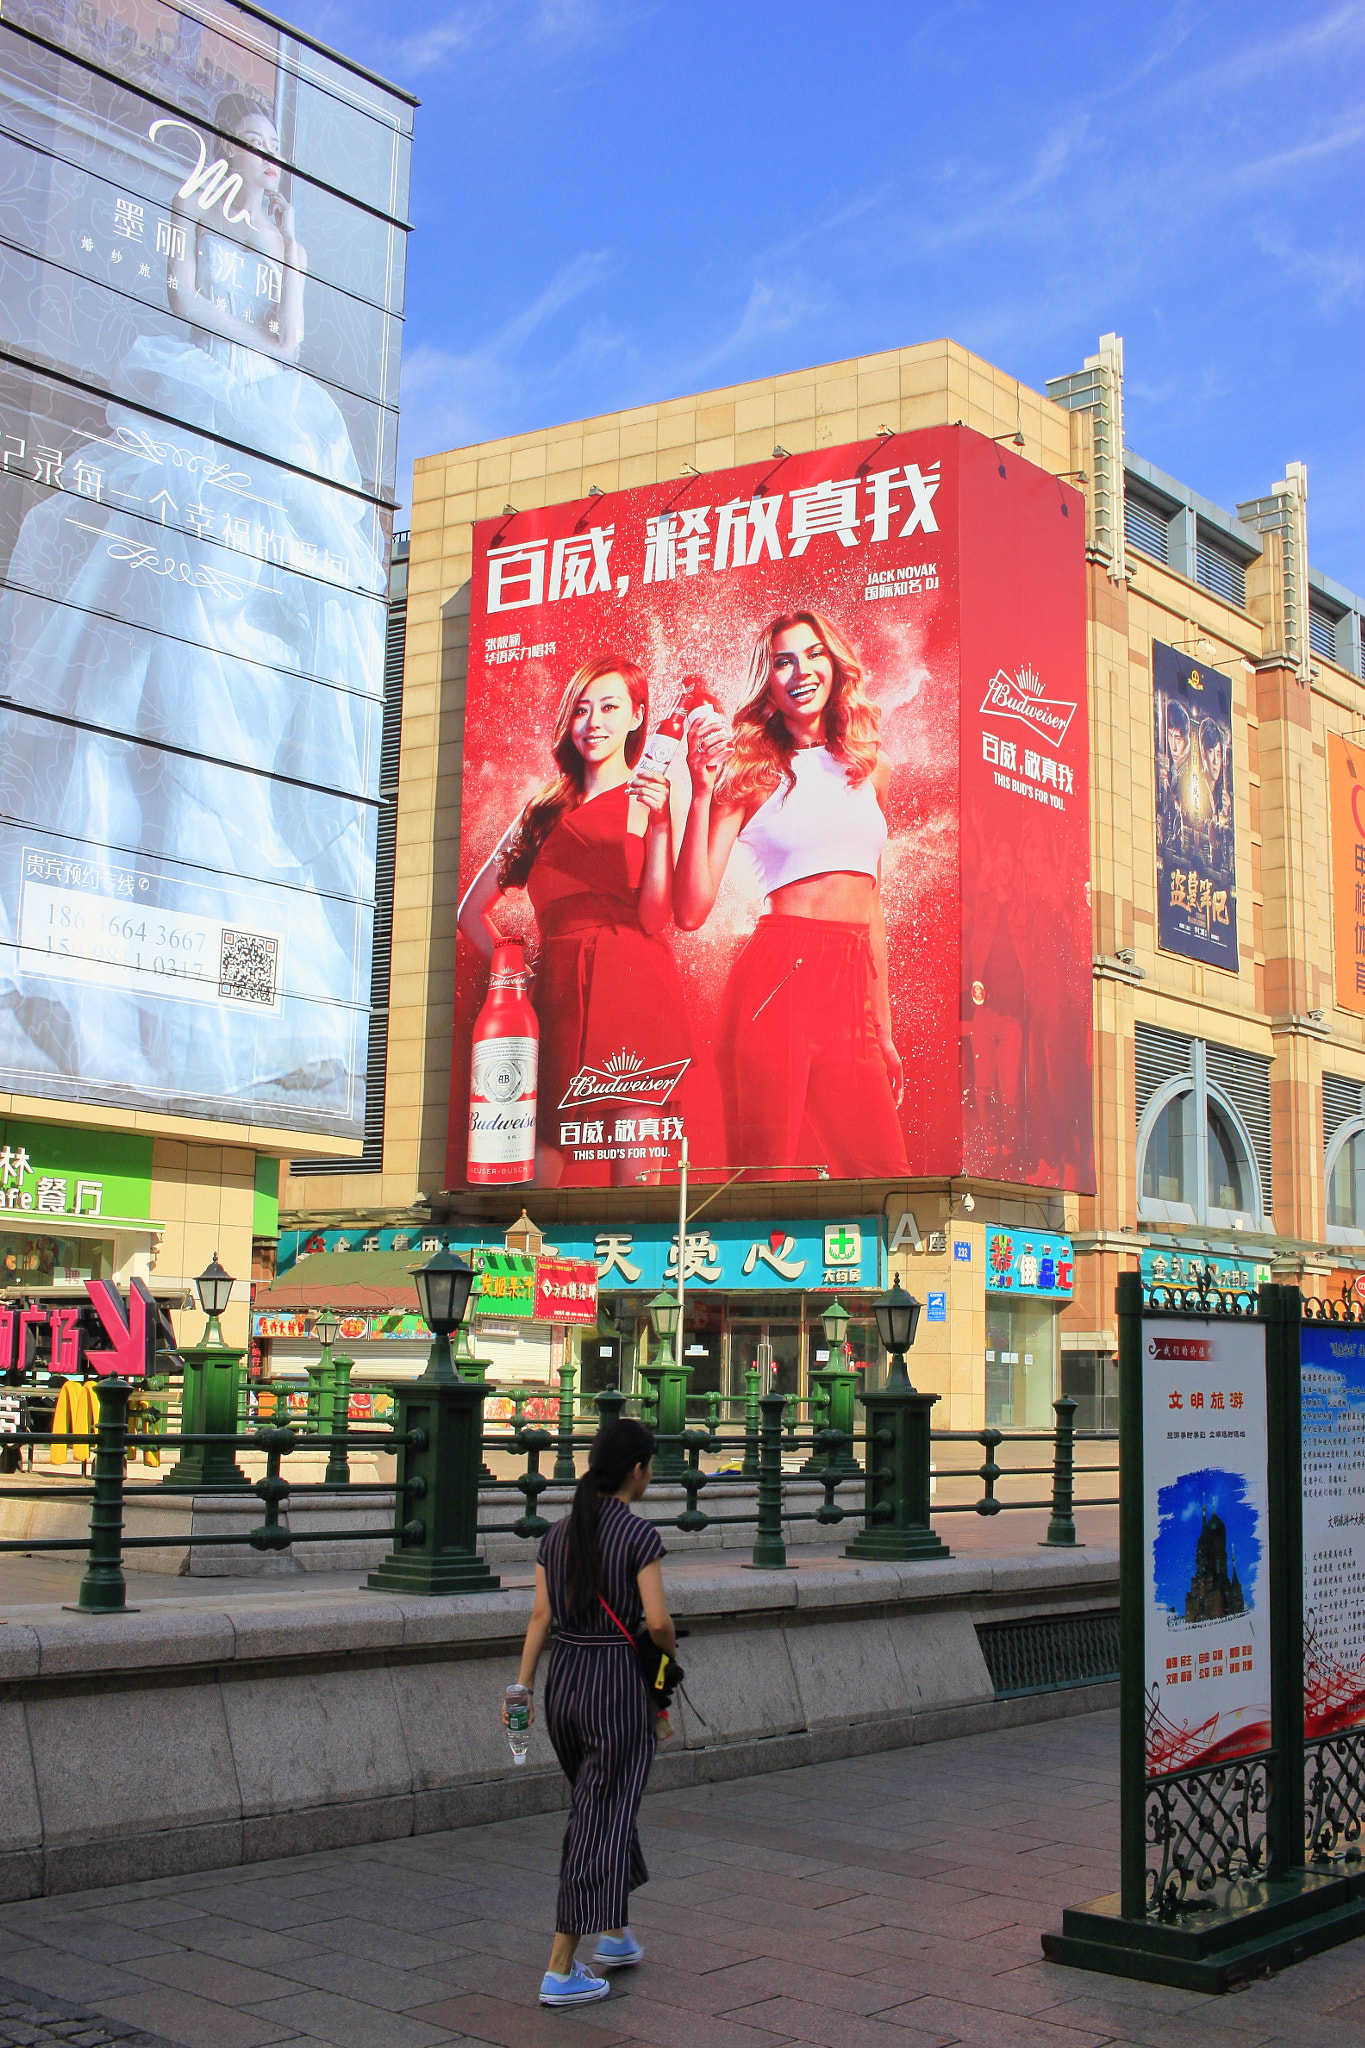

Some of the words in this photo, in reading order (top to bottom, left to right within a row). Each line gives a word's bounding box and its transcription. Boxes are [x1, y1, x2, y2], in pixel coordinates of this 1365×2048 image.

[81, 236, 304, 342] 婚纱旅拍/婚礼摄
[866, 568, 896, 586] JACK
[896, 562, 937, 581] NOVAK
[865, 578, 922, 601] 国际知名
[925, 576, 939, 591] DJ
[988, 678, 1068, 730] Budweiser
[993, 771, 1011, 789] THIS
[1011, 778, 1034, 799] BUD'S
[1034, 787, 1049, 805] FOR
[156, 925, 206, 953] 3667
[569, 1074, 676, 1098] Budweiser
[573, 1149, 595, 1161] THIS
[597, 1149, 626, 1160] BUD'S
[628, 1148, 647, 1159] FOR
[648, 1146, 671, 1158] YOU.
[472, 1165, 528, 1175] EUSER-BUSCH
[37, 1176, 103, 1216] 餐厅
[542, 1230, 807, 1283] 天爱心
[1168, 1390, 1244, 1410] 文明旅游
